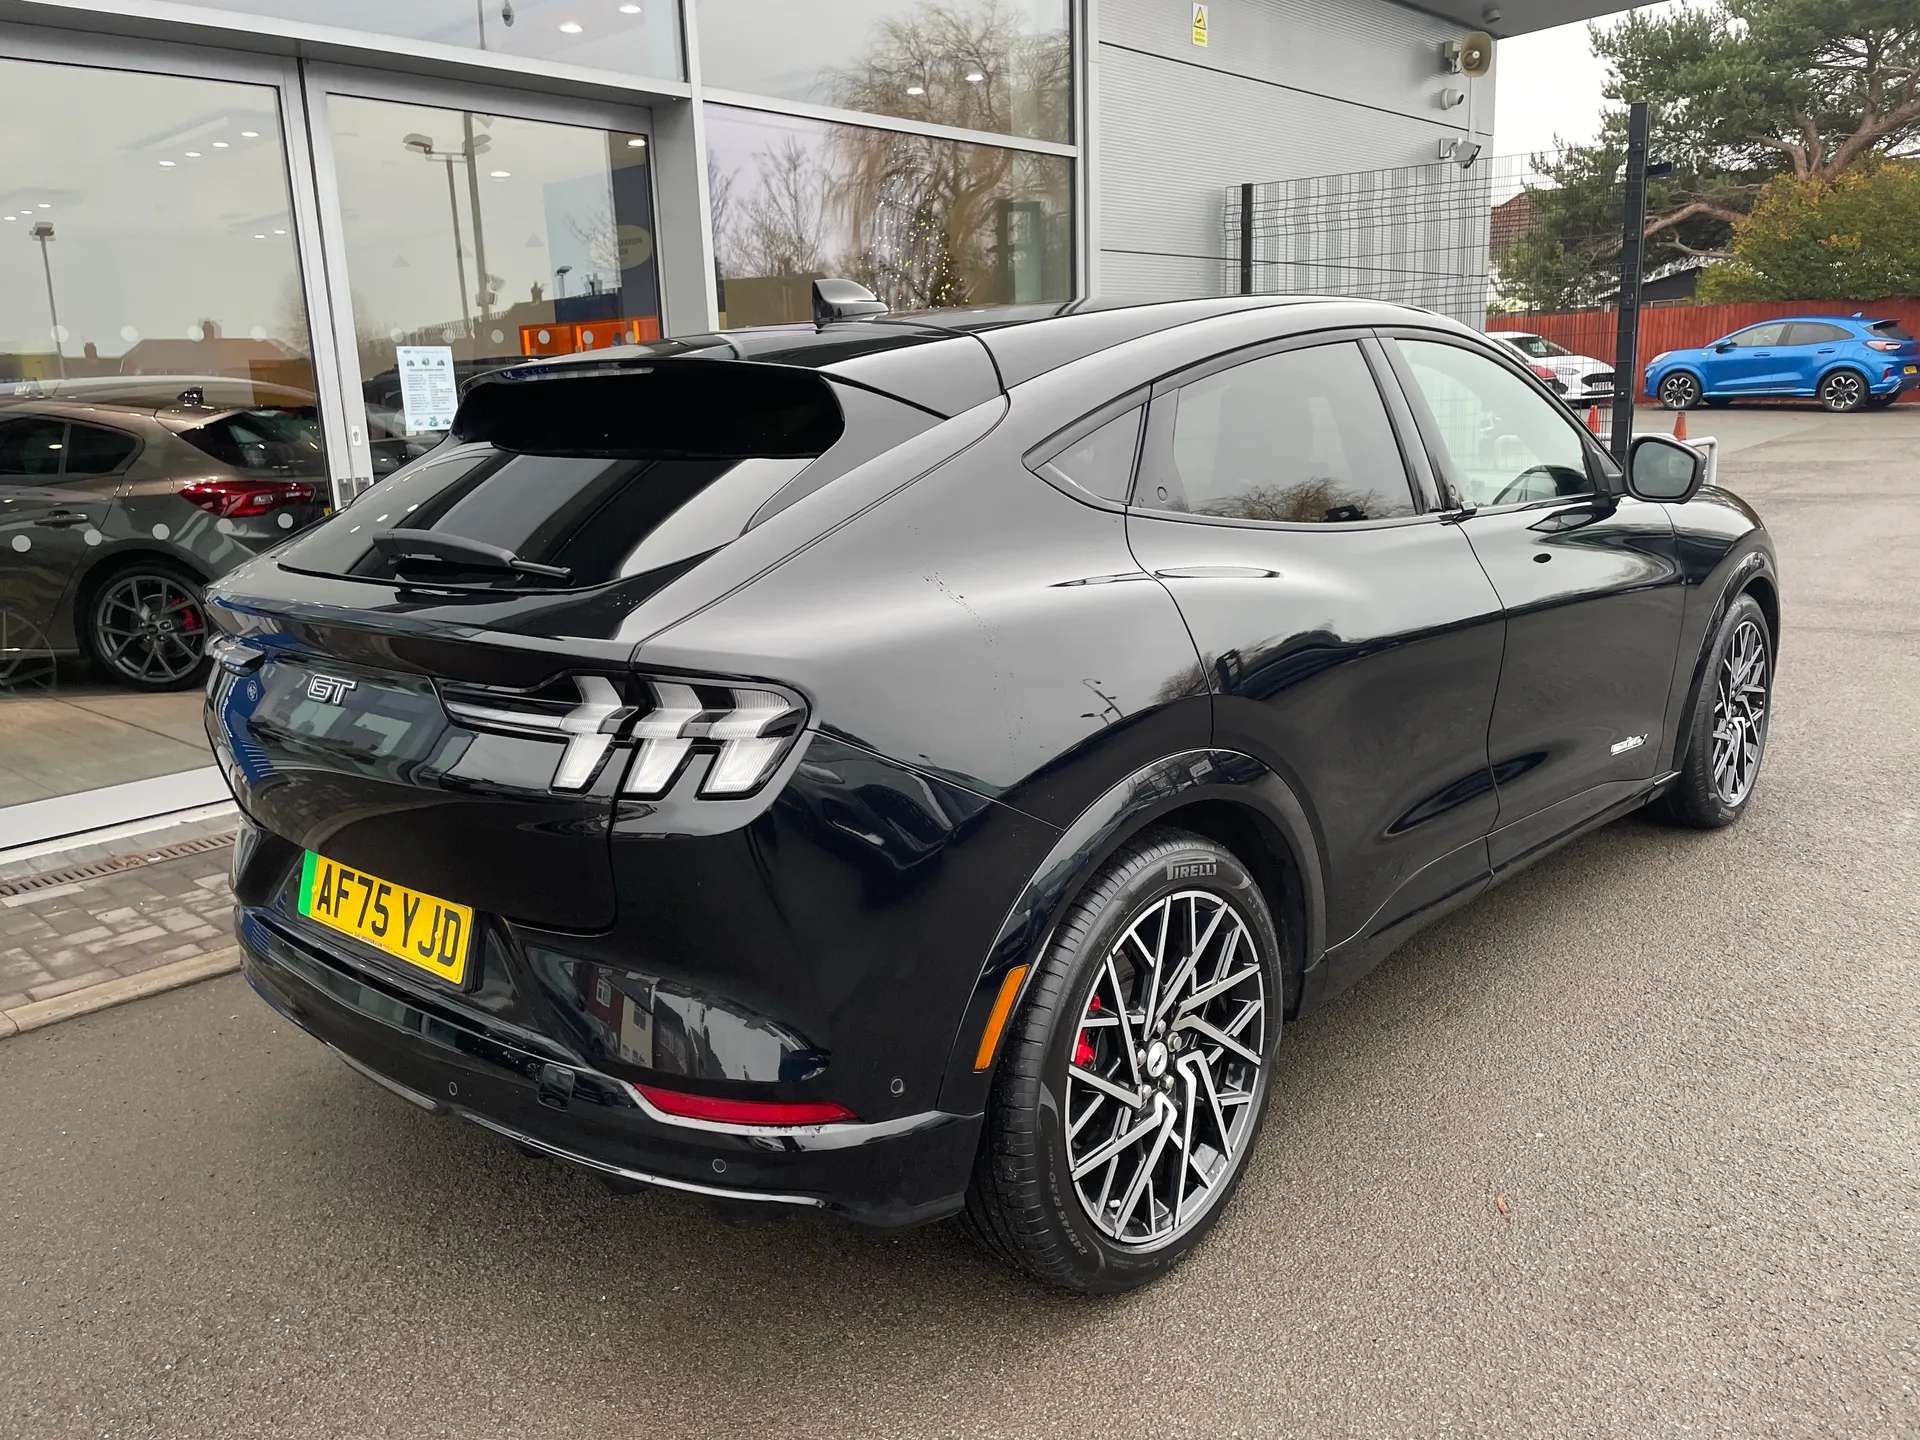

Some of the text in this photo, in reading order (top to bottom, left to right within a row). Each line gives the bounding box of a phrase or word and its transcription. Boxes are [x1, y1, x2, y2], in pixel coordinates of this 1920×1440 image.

[307, 674, 356, 704] GT
[1167, 856, 1216, 880] PIRELLI
[317, 864, 461, 967] AF75 YJD
